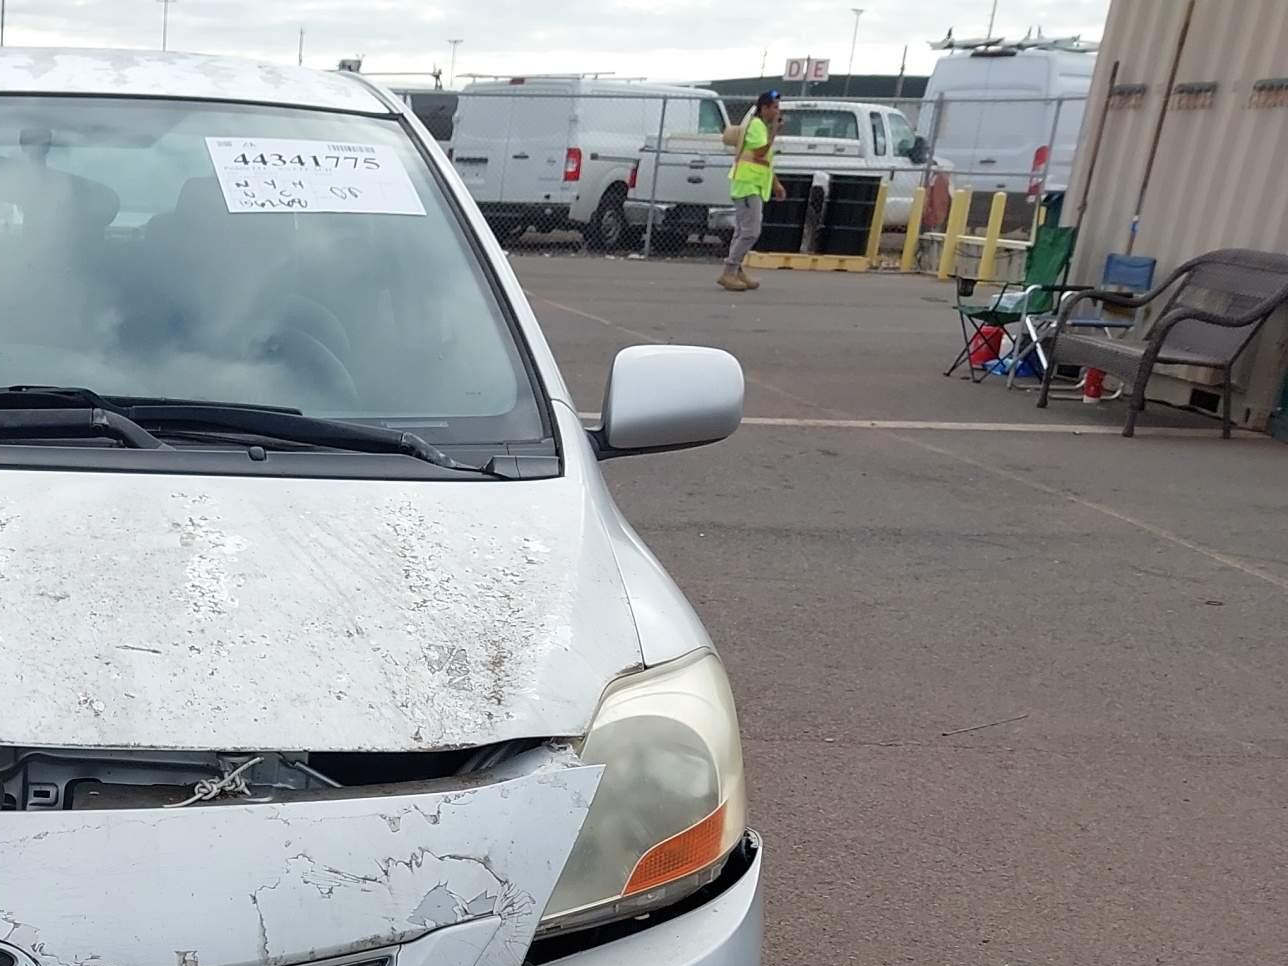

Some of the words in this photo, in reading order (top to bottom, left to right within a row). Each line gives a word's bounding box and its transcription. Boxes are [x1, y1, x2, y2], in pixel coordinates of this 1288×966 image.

[788, 60, 800, 78] D
[814, 60, 825, 78] E
[233, 152, 381, 170] 44341775
